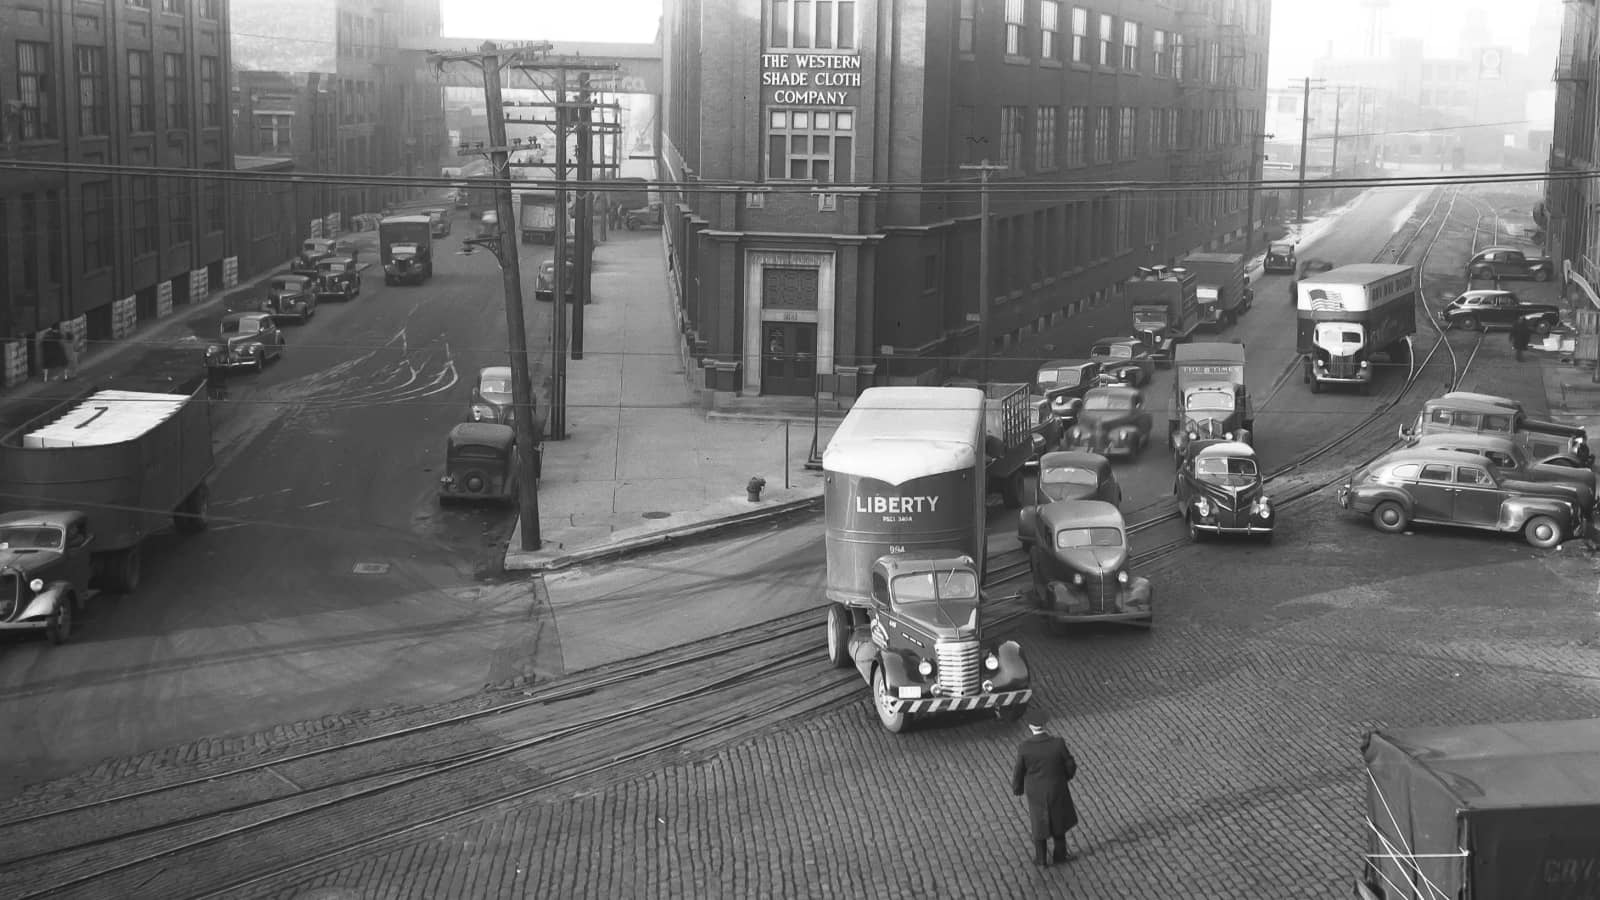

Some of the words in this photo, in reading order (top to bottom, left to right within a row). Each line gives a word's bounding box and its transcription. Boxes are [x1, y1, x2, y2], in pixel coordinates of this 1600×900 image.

[761, 54, 789, 68] THE
[795, 54, 861, 69] WESTERN
[762, 71, 809, 86] SHADE
[815, 72, 861, 87] CLOTH
[774, 89, 848, 105] COMPANY
[856, 496, 939, 513] LIBERTY
